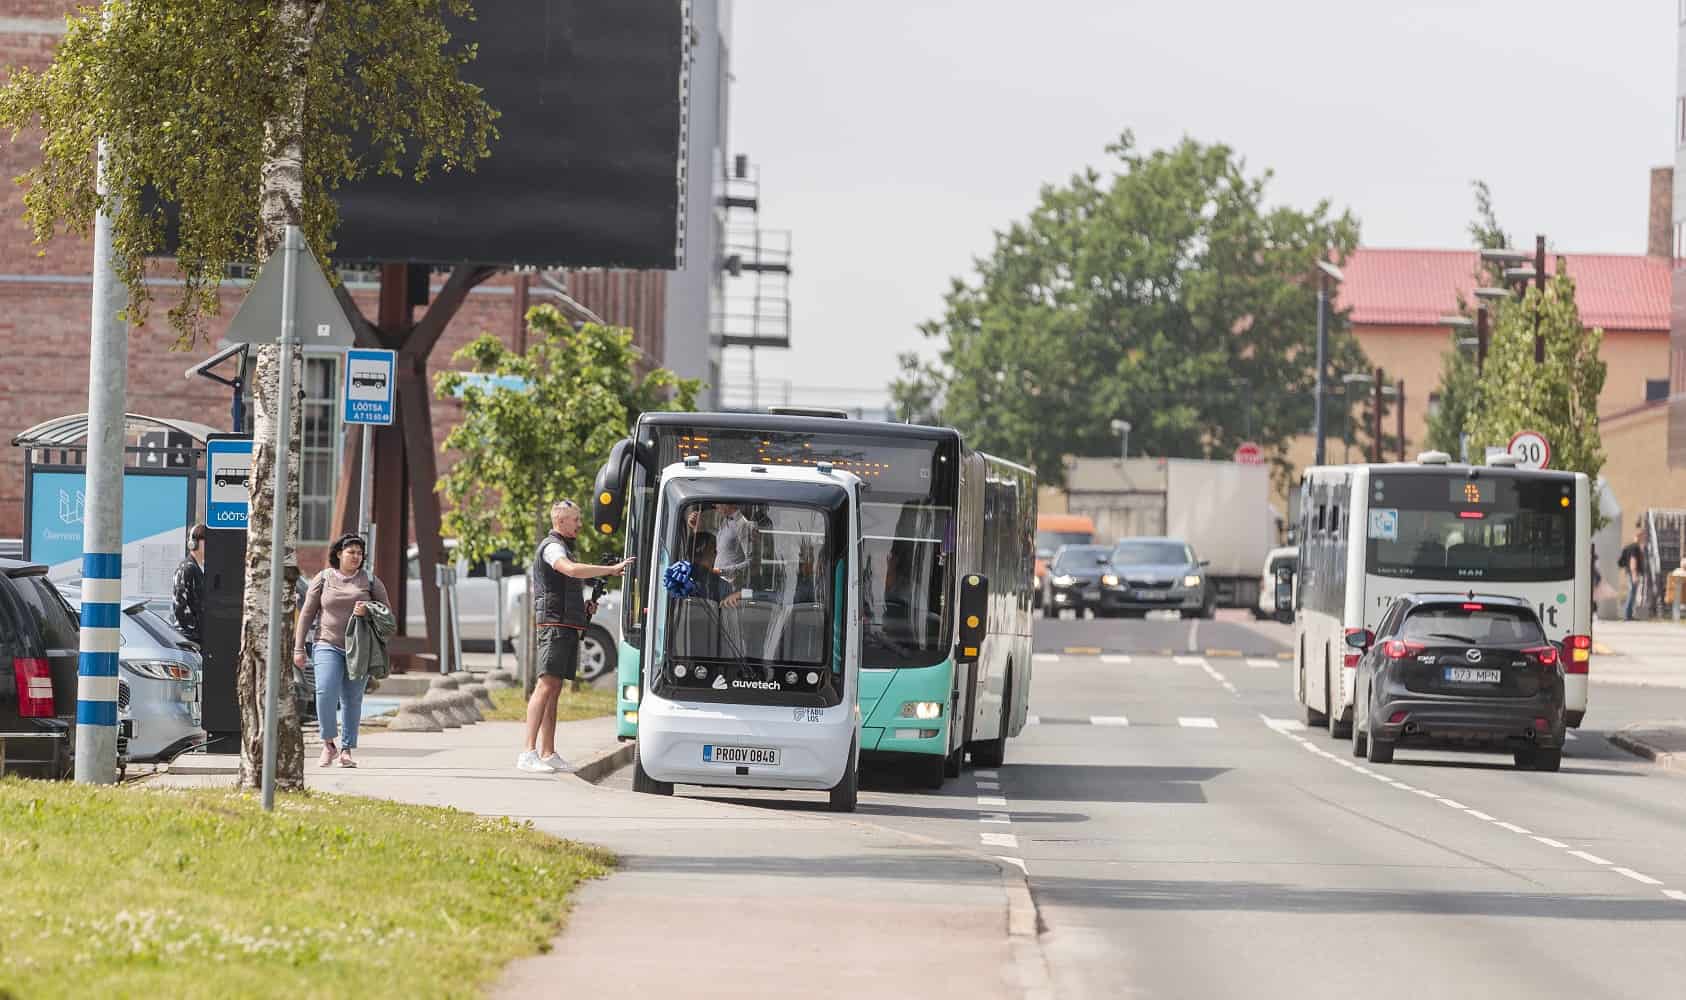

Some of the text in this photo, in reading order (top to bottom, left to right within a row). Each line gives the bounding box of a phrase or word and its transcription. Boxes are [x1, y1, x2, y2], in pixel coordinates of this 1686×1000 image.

[1518, 443, 1541, 464] 30
[1458, 569, 1483, 577] MAN
[732, 679, 781, 691] auvetech
[715, 748, 775, 763] PROOV 0848
